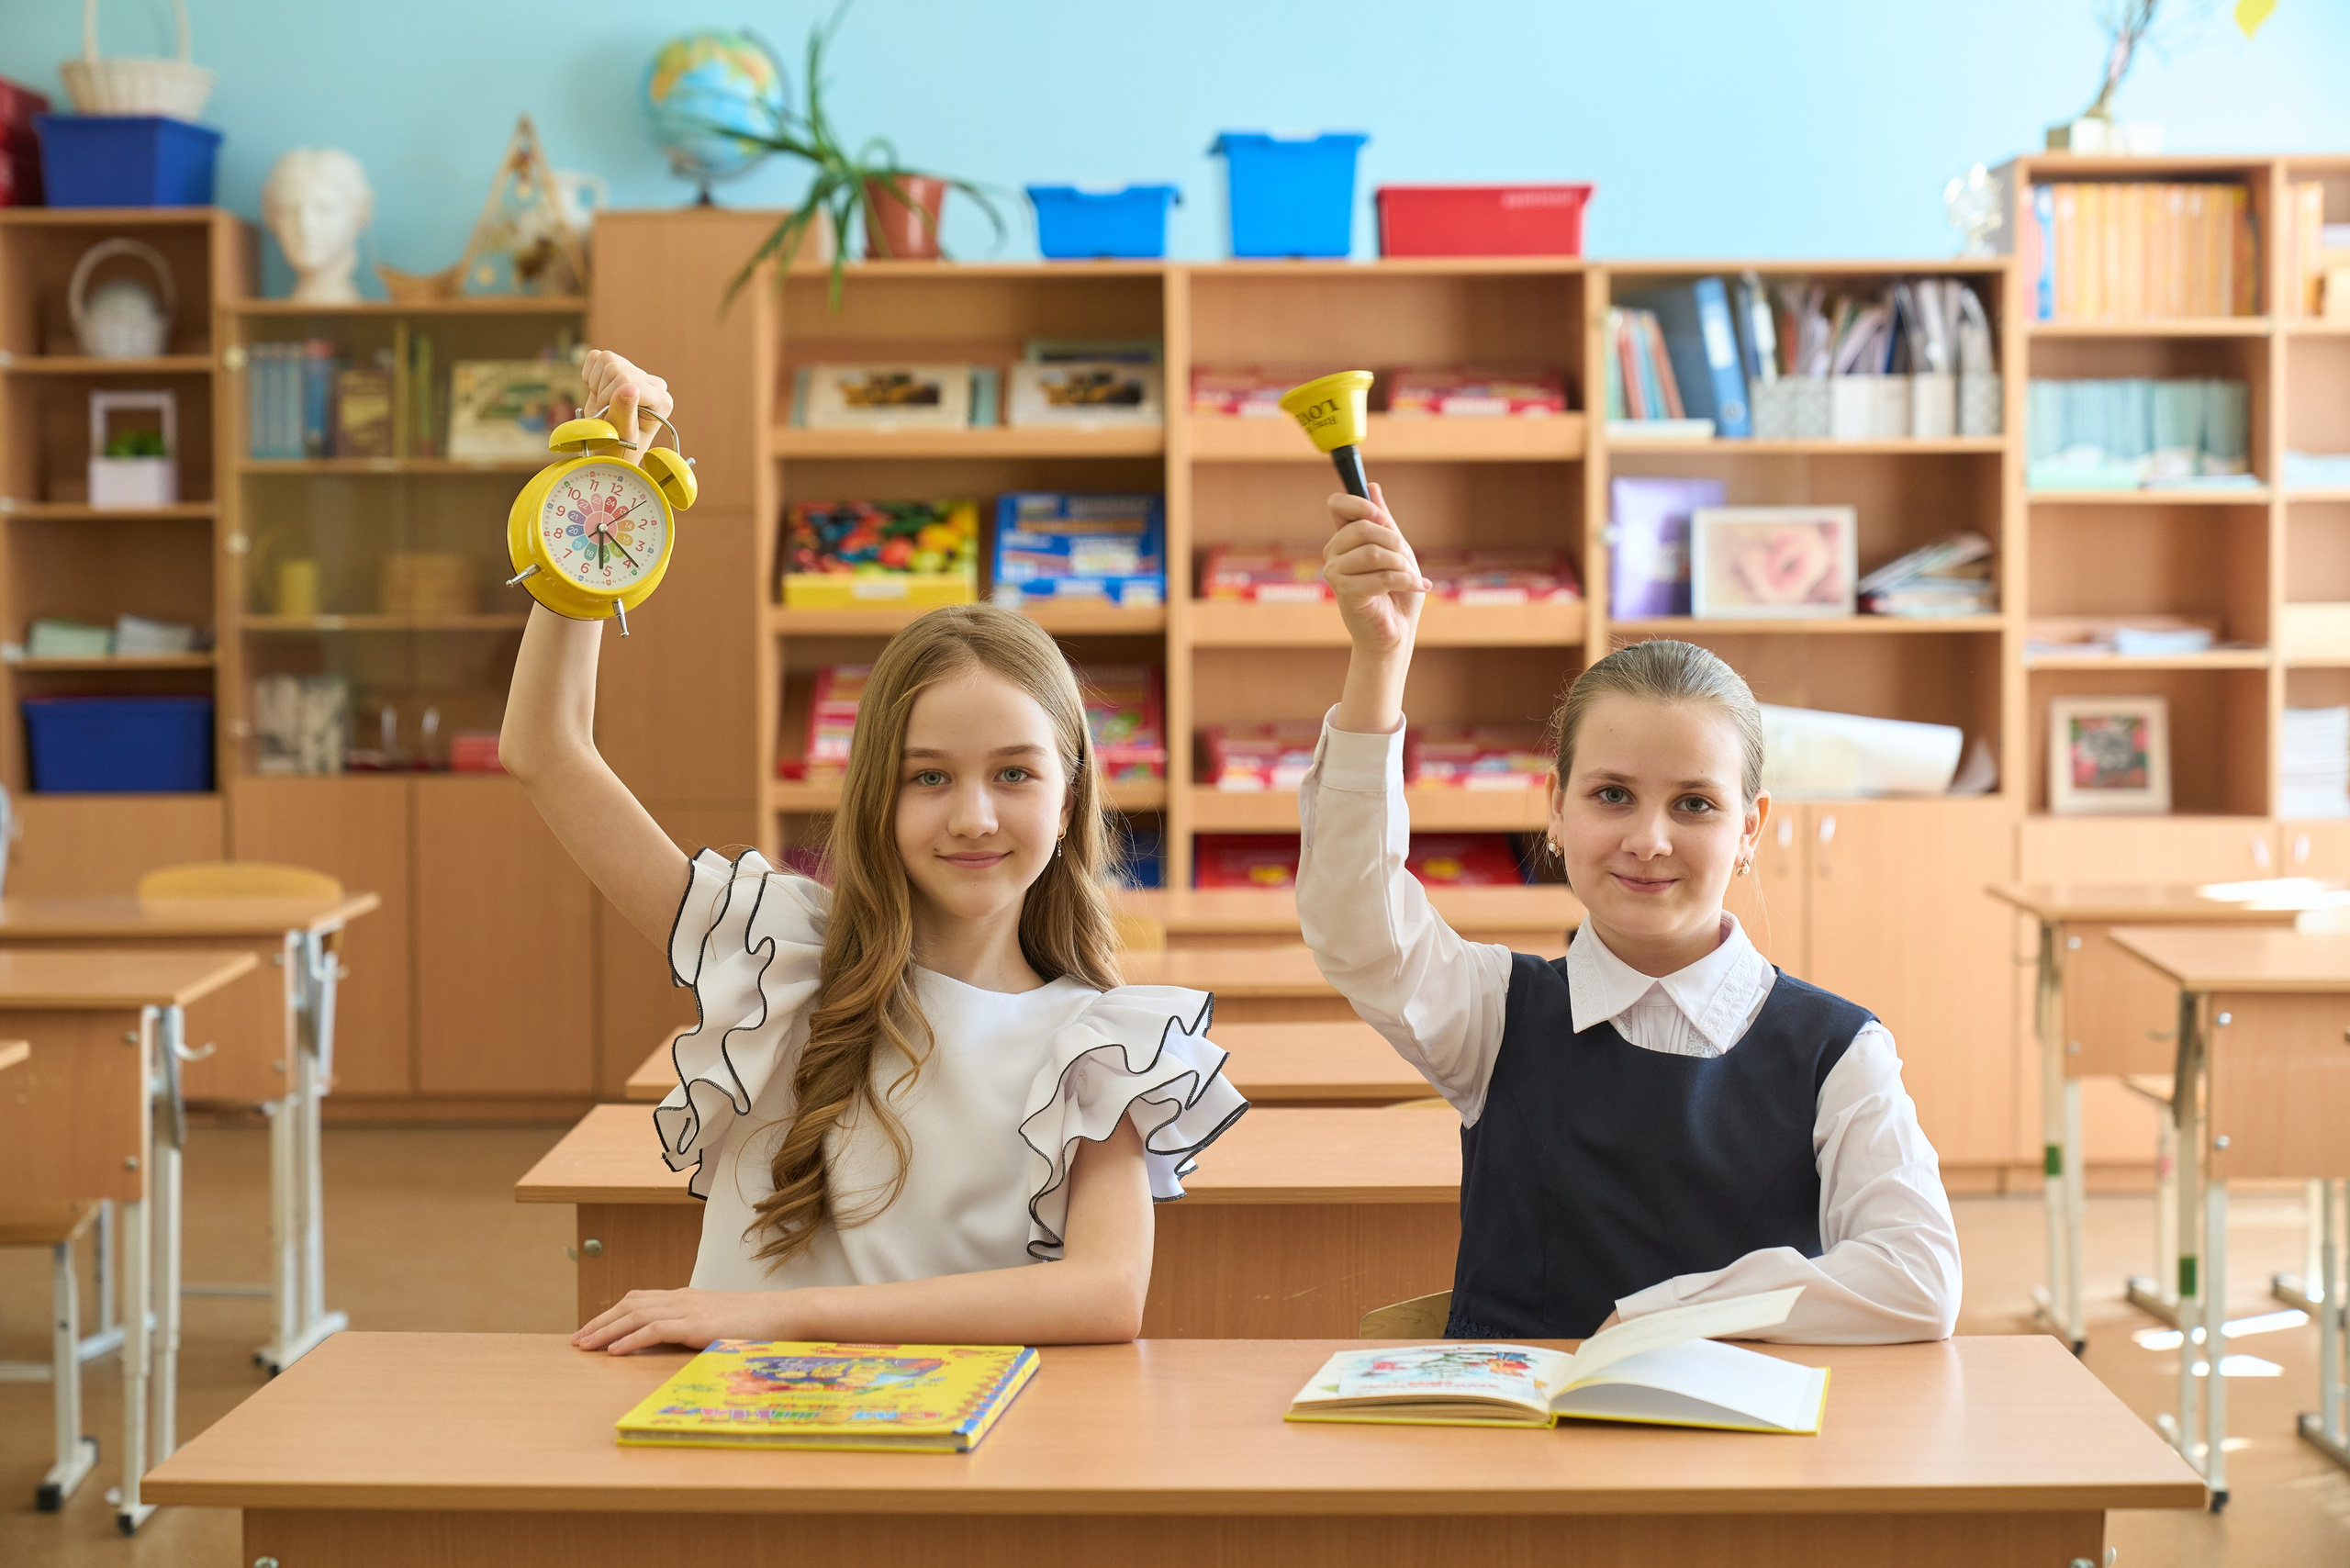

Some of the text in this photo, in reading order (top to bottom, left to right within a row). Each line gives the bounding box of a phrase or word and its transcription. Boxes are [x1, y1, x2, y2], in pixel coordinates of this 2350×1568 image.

[589, 479, 599, 492] 11
[610, 482, 623, 497] 12
[567, 487, 581, 500] 10
[578, 500, 588, 510] 22
[592, 496, 601, 505] 23
[606, 498, 615, 508] 24
[631, 497, 637, 509] 1
[555, 505, 565, 517] 9
[569, 512, 578, 521] 21
[619, 508, 627, 516] 13
[568, 526, 578, 535] 20
[624, 521, 632, 530] 14
[638, 518, 648, 531] 2
[554, 527, 564, 539] 8
[575, 540, 583, 548] 19
[635, 540, 645, 552] 3
[563, 547, 573, 559] 7
[586, 549, 594, 557] 18
[580, 562, 590, 574] 6
[622, 559, 632, 569] 4
[602, 565, 613, 577] 5
